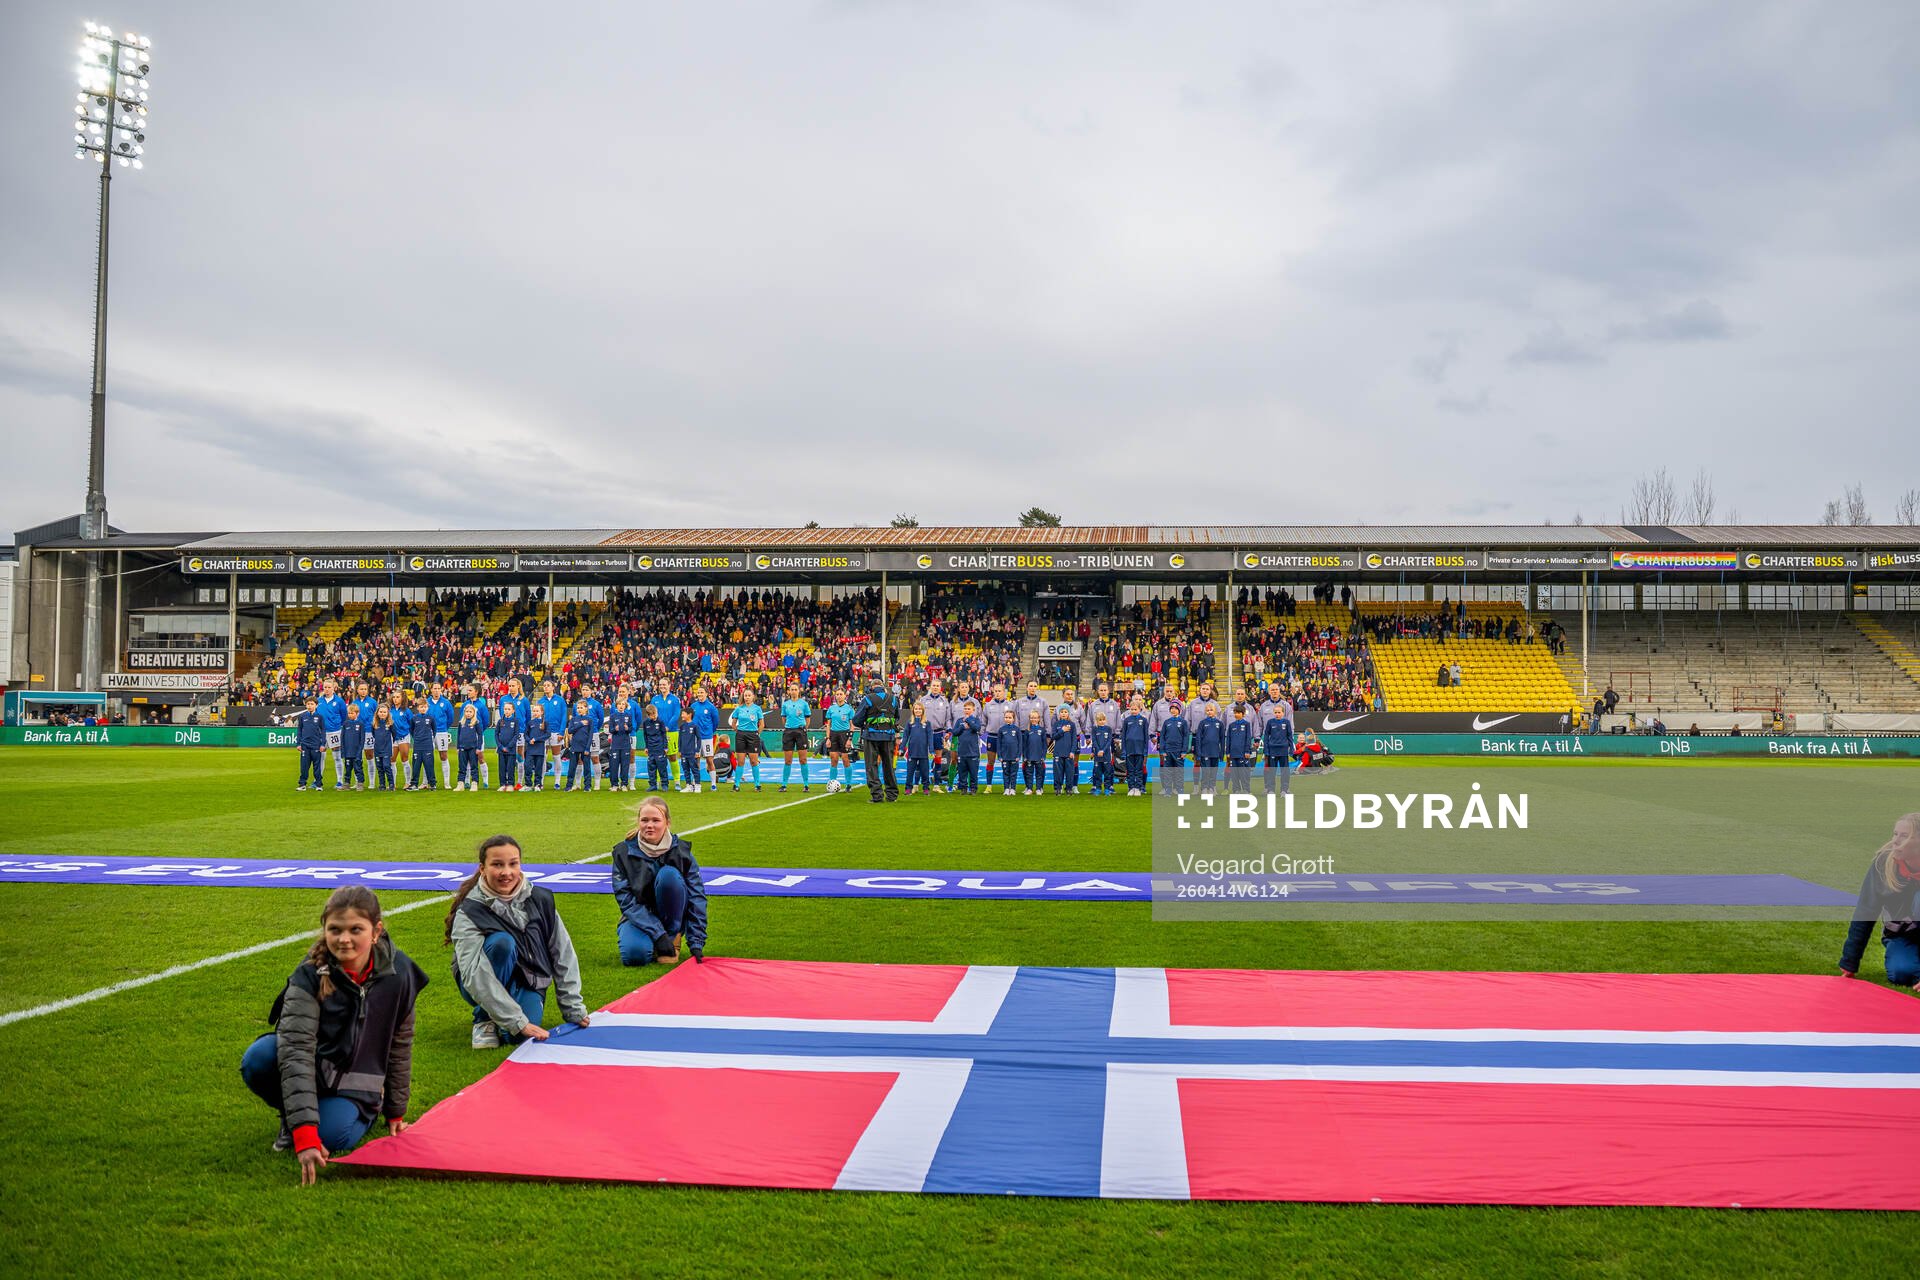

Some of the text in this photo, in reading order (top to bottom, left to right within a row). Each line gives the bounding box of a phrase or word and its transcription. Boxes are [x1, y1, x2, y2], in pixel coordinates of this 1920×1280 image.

[204, 560, 285, 570] CHARTERBUSS.no
[314, 559, 396, 569] CHARTERBUSS.no
[425, 559, 509, 569] CHARTERBUSS.no
[654, 558, 742, 568] CHARTERBUSS.no
[772, 558, 861, 568] CHARTERBUSS.no
[949, 556, 1070, 568] CHARTERBUSS.no
[1078, 556, 1154, 567] TRIBUNEN
[1261, 556, 1353, 567] CHARTERBUSS.no
[1383, 556, 1478, 567] CHARTERBUSS.no
[1636, 556, 1730, 566] CHARTERBUSS.no
[1762, 556, 1857, 567] CHARTERBUSS.no
[1047, 643, 1073, 654] ecit
[131, 654, 185, 667] CREATIVE
[108, 676, 199, 686] HVAM INVEST.NO
[24, 728, 109, 742] Bank fra A til Å
[175, 728, 200, 745] DNB
[268, 733, 298, 744] Bank
[1374, 736, 1403, 755] DNB
[1481, 737, 1583, 752] Bank fra A til Å
[1661, 737, 1690, 756] DNB
[1769, 739, 1872, 754] Bank fra A til Å
[0, 860, 108, 873] 'S
